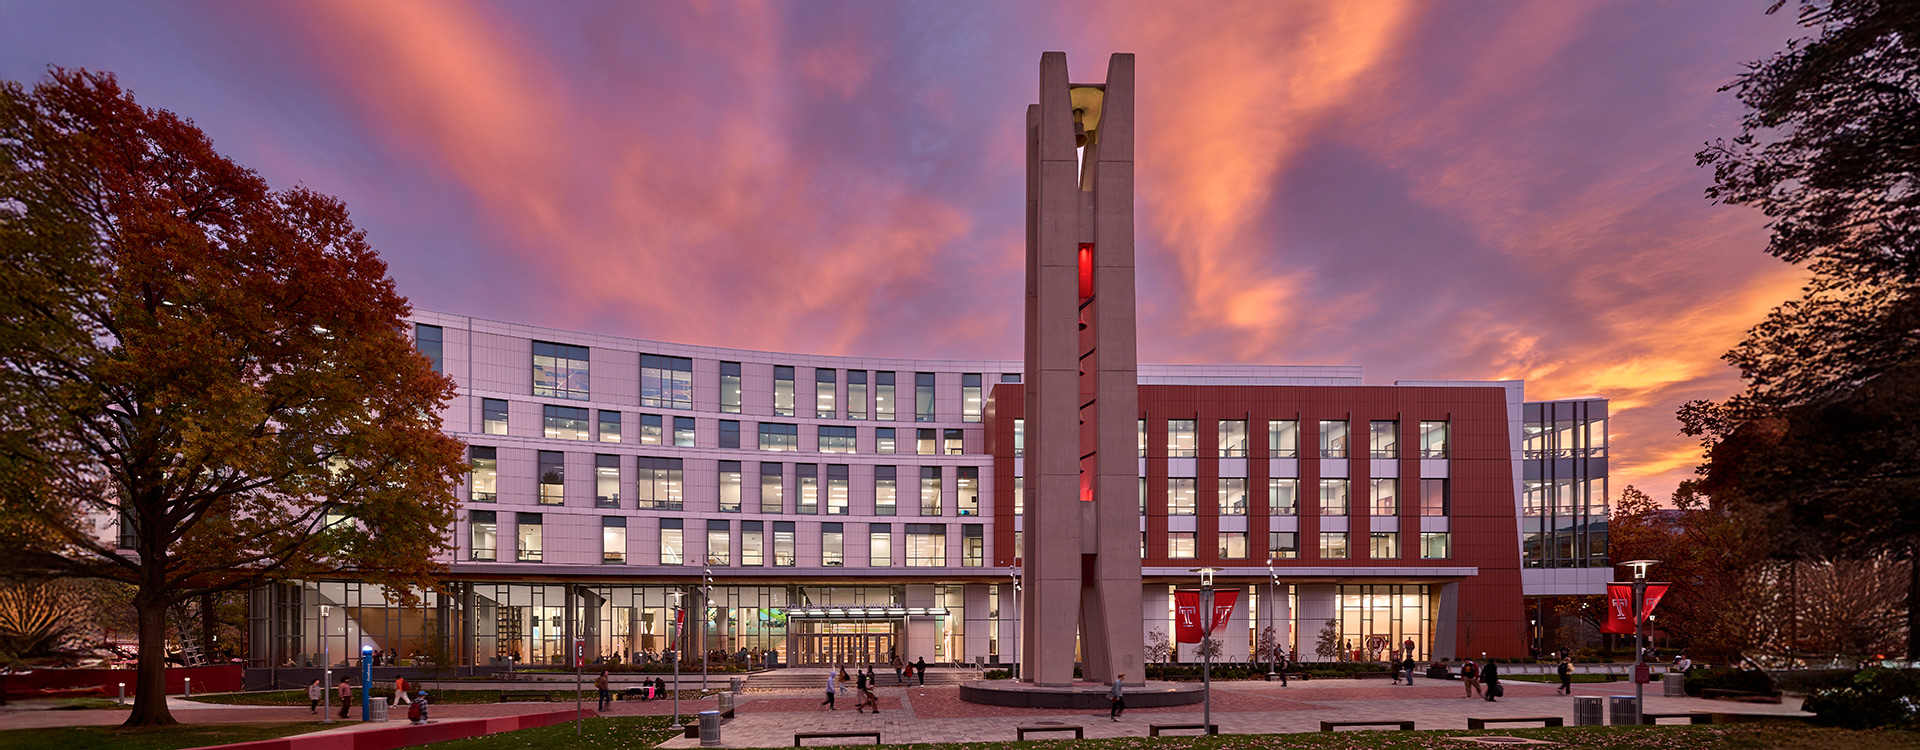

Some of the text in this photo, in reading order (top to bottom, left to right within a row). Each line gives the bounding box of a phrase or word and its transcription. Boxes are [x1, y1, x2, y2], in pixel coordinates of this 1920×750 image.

[1179, 606, 1195, 627] T
[1216, 605, 1232, 626] T
[1612, 599, 1627, 619] T
